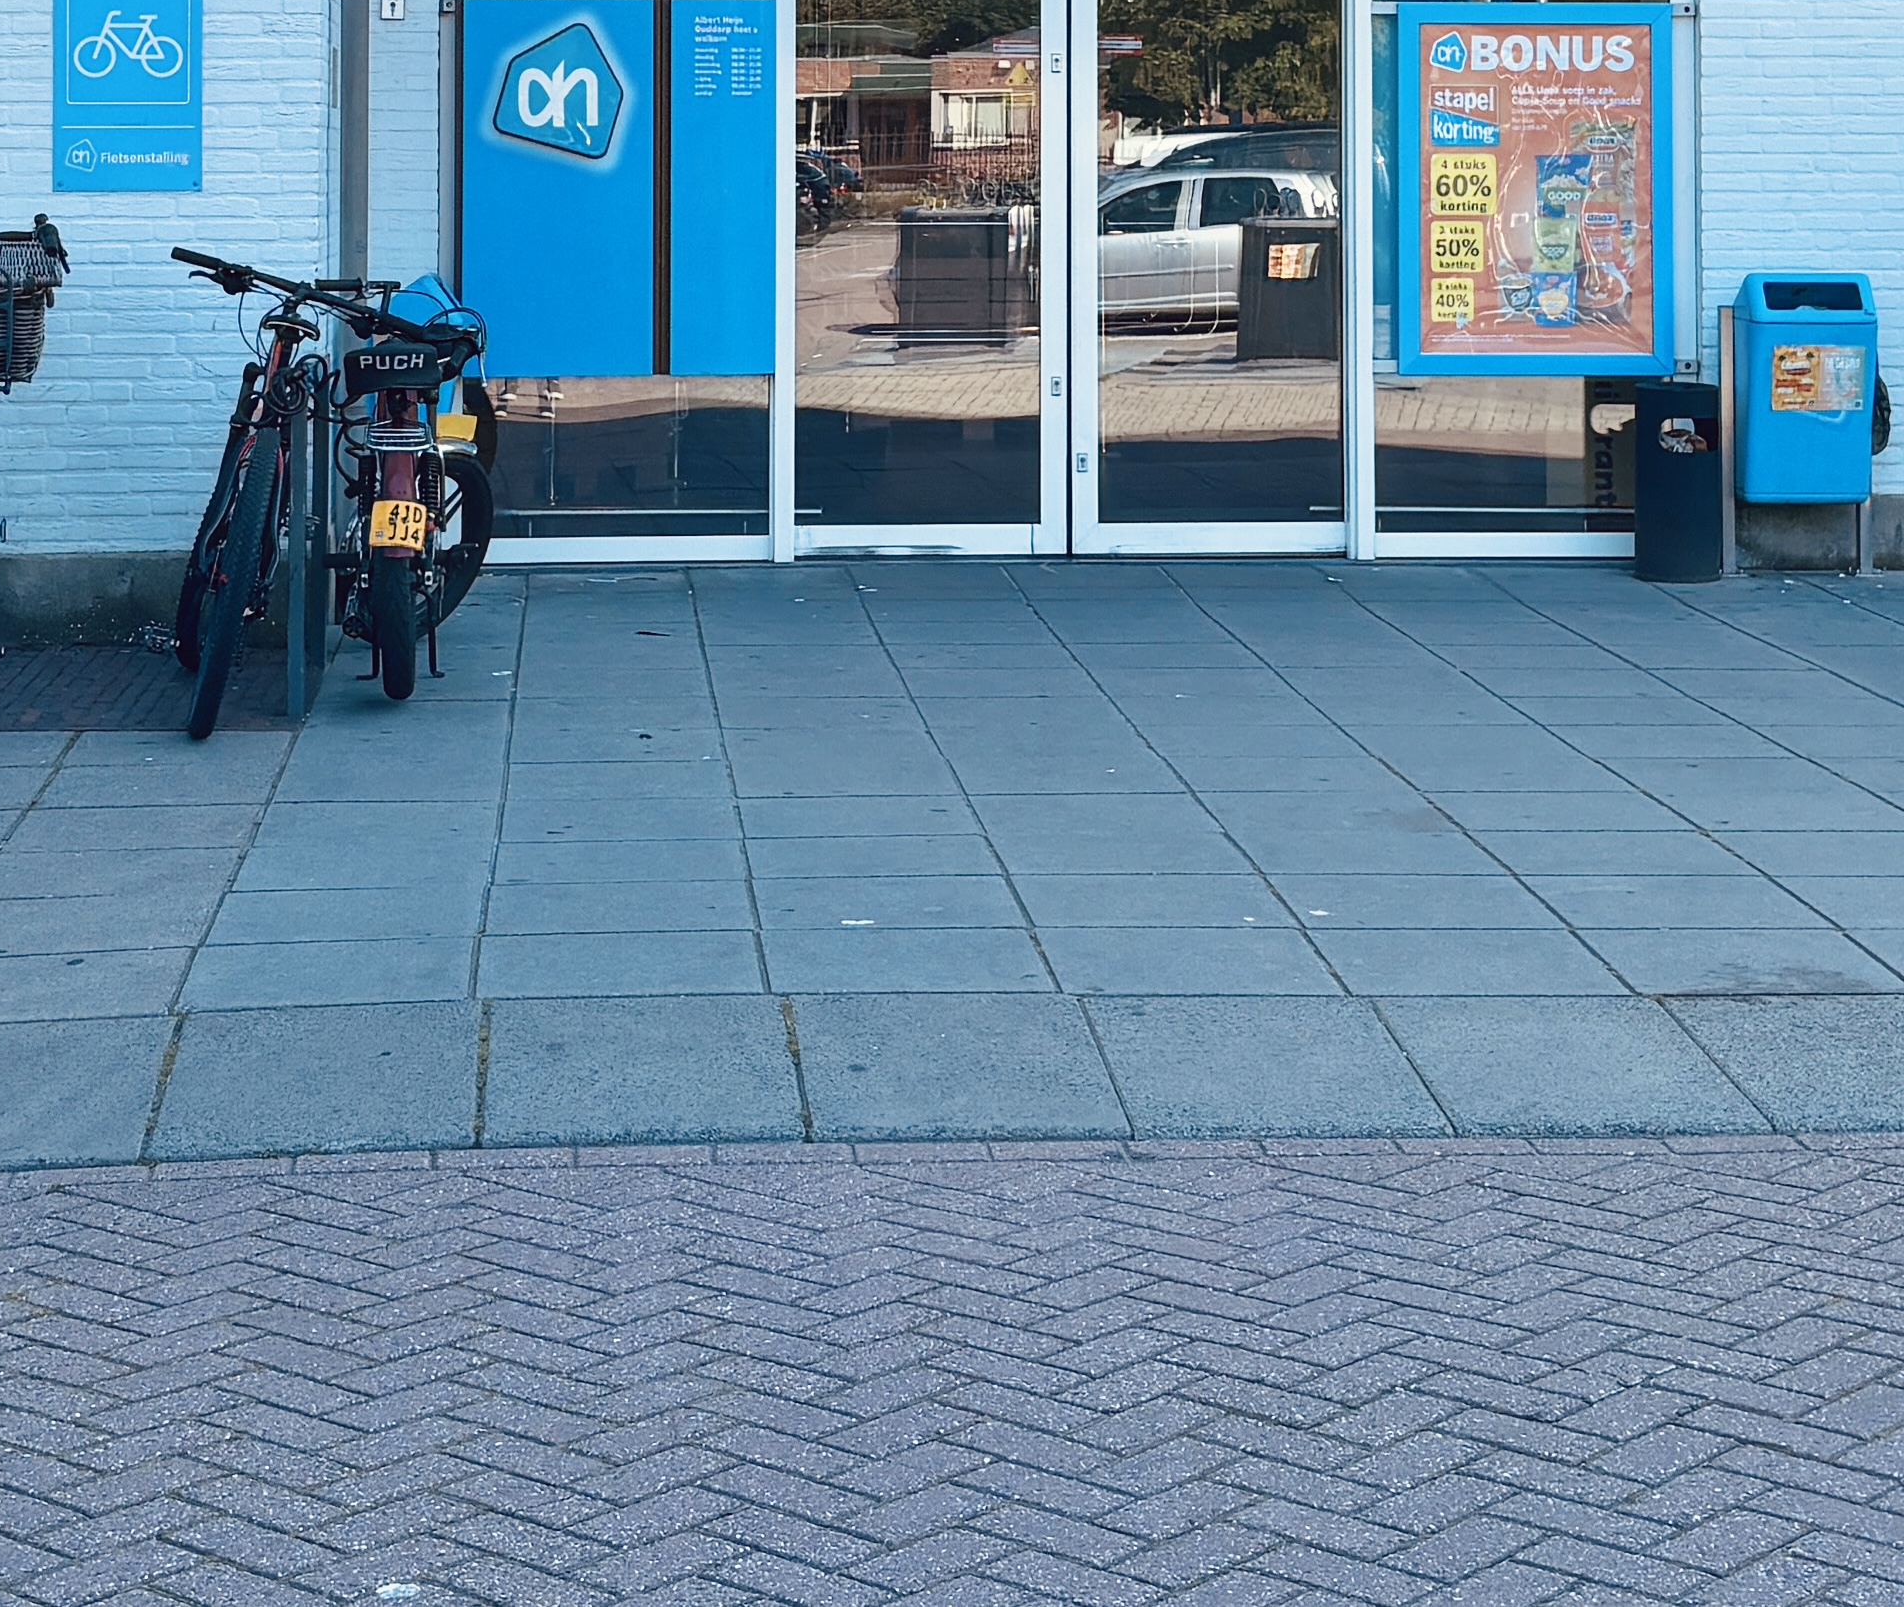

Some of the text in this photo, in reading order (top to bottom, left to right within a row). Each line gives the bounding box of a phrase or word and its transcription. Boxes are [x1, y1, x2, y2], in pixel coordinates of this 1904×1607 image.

[695, 16, 721, 24] Albert
[1470, 35, 1635, 72] BONUS
[1434, 87, 1494, 113] stapel
[1433, 115, 1496, 144] korting
[100, 151, 190, 166] Fietsenstalling
[1441, 159, 1487, 170] 4 stuks
[1435, 174, 1492, 198] 60%
[1548, 191, 1581, 201] GOOD
[1440, 200, 1488, 213] korting
[1435, 239, 1480, 257] 50%
[1439, 260, 1477, 270] korting
[1435, 294, 1470, 308] 40%
[359, 354, 425, 370] PUCH
